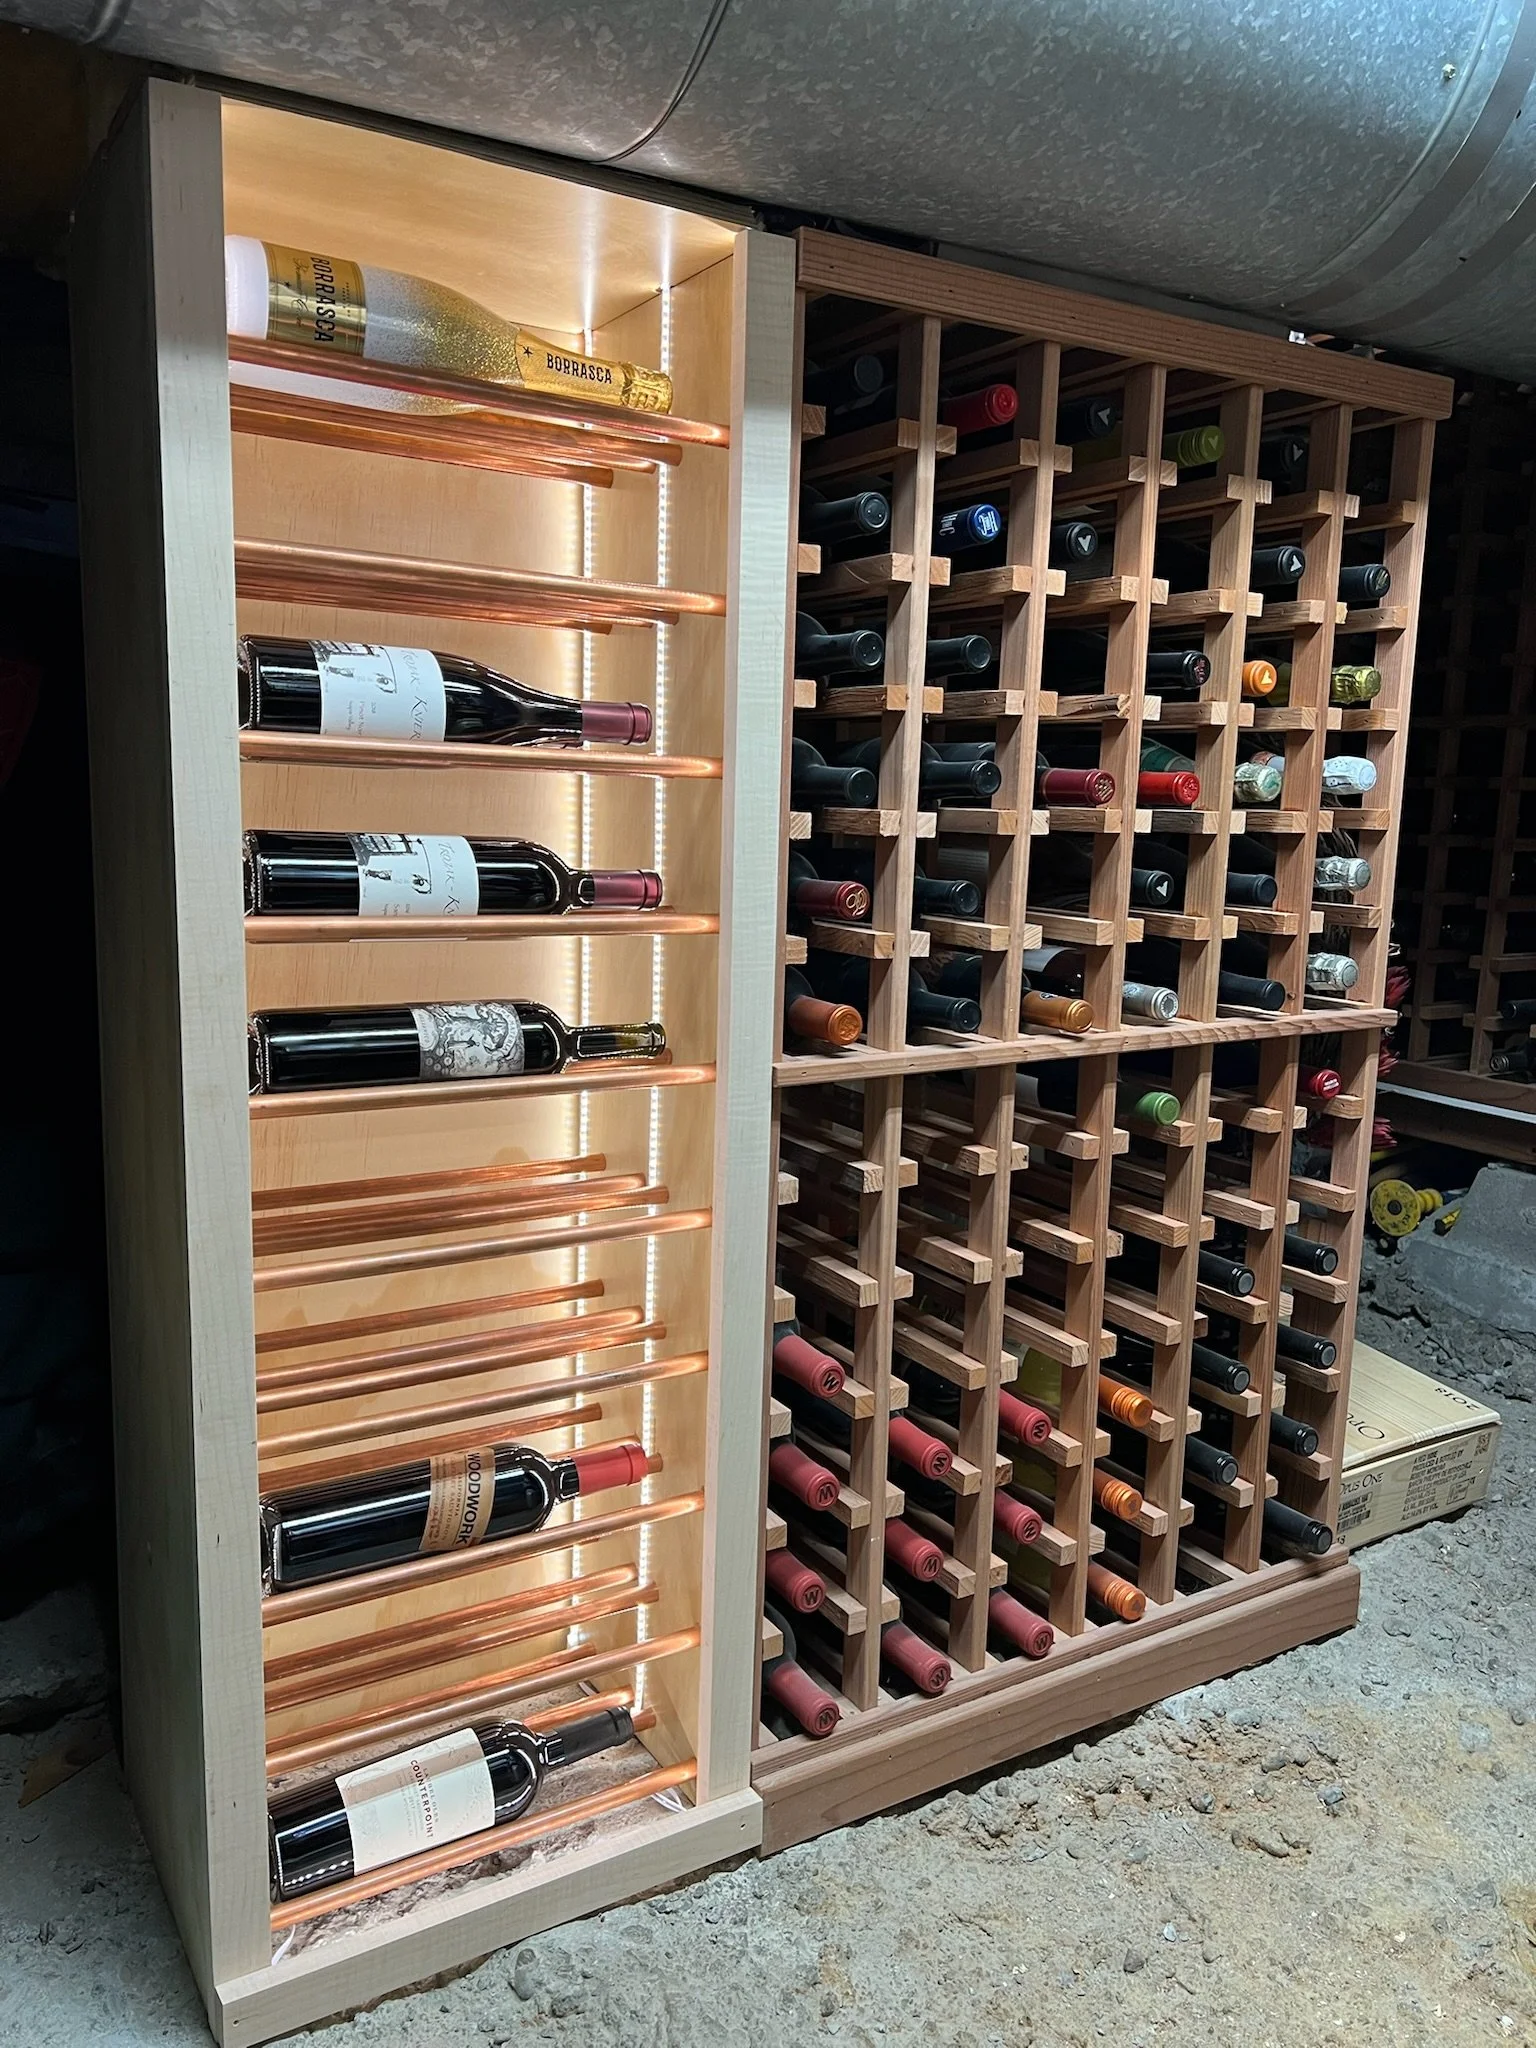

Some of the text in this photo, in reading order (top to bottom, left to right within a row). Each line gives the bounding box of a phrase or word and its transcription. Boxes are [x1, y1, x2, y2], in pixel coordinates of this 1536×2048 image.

[309, 256, 335, 344] BORRASCA
[546, 352, 612, 385] BORRASCA
[454, 1472, 463, 1517] CALIFORNIA
[456, 1452, 481, 1545] WOODWORK
[1362, 1472, 1384, 1486] ONE
[410, 1760, 434, 1838] COUNTERPOINT
